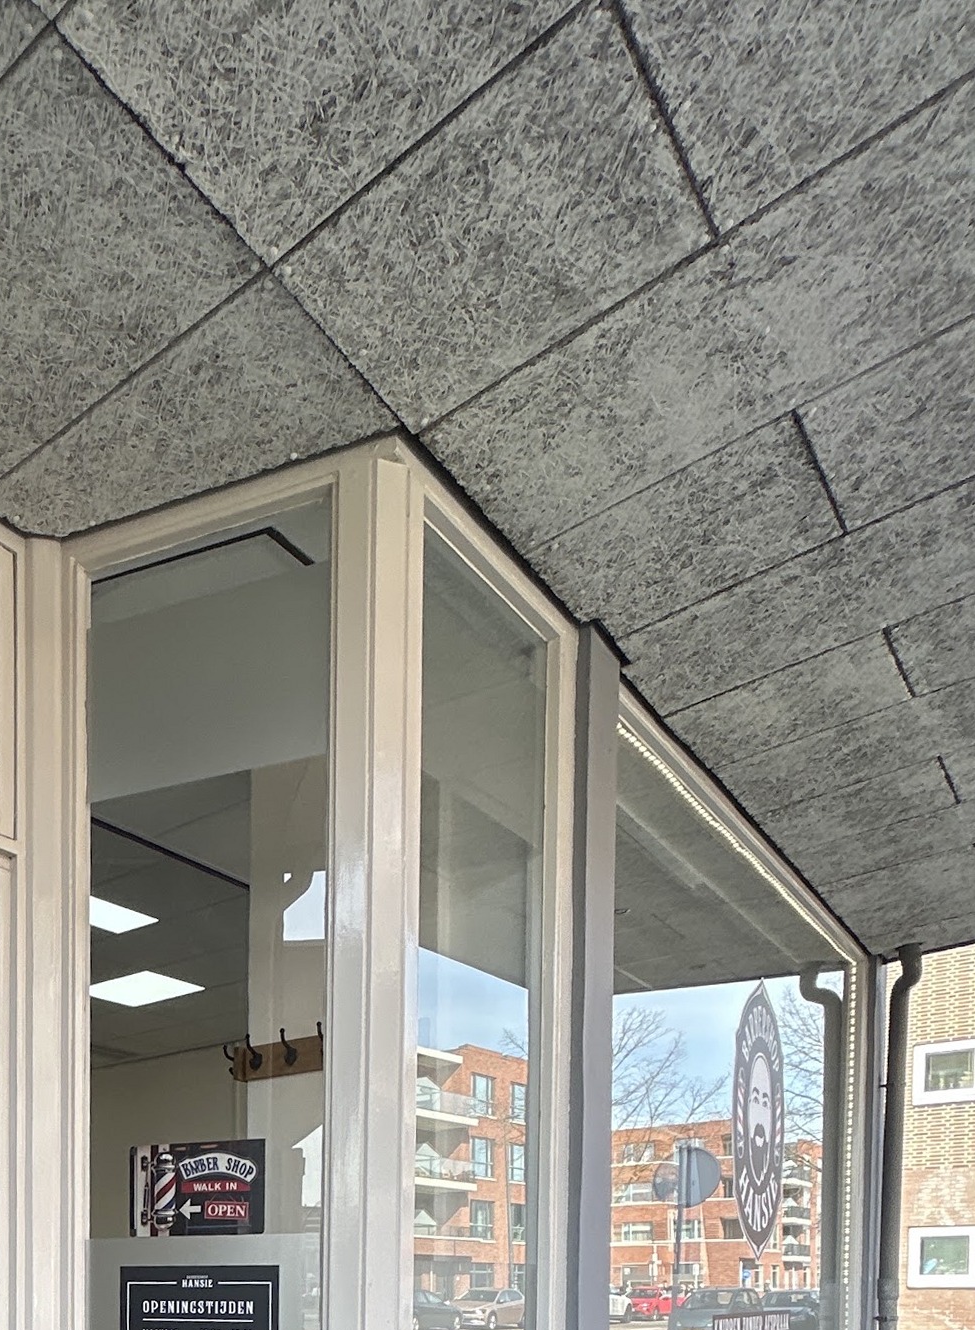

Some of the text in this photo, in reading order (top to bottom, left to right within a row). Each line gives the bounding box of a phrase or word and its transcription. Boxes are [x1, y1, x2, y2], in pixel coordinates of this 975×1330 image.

[181, 1156, 255, 1180] BARBER SHOP
[193, 1181, 237, 1192] WALK IN
[739, 1165, 778, 1232] HANSIE
[207, 1204, 246, 1217] OPEN
[181, 1279, 213, 1288] HANSIE
[142, 1300, 254, 1315] OPENINGSTIJDEN
